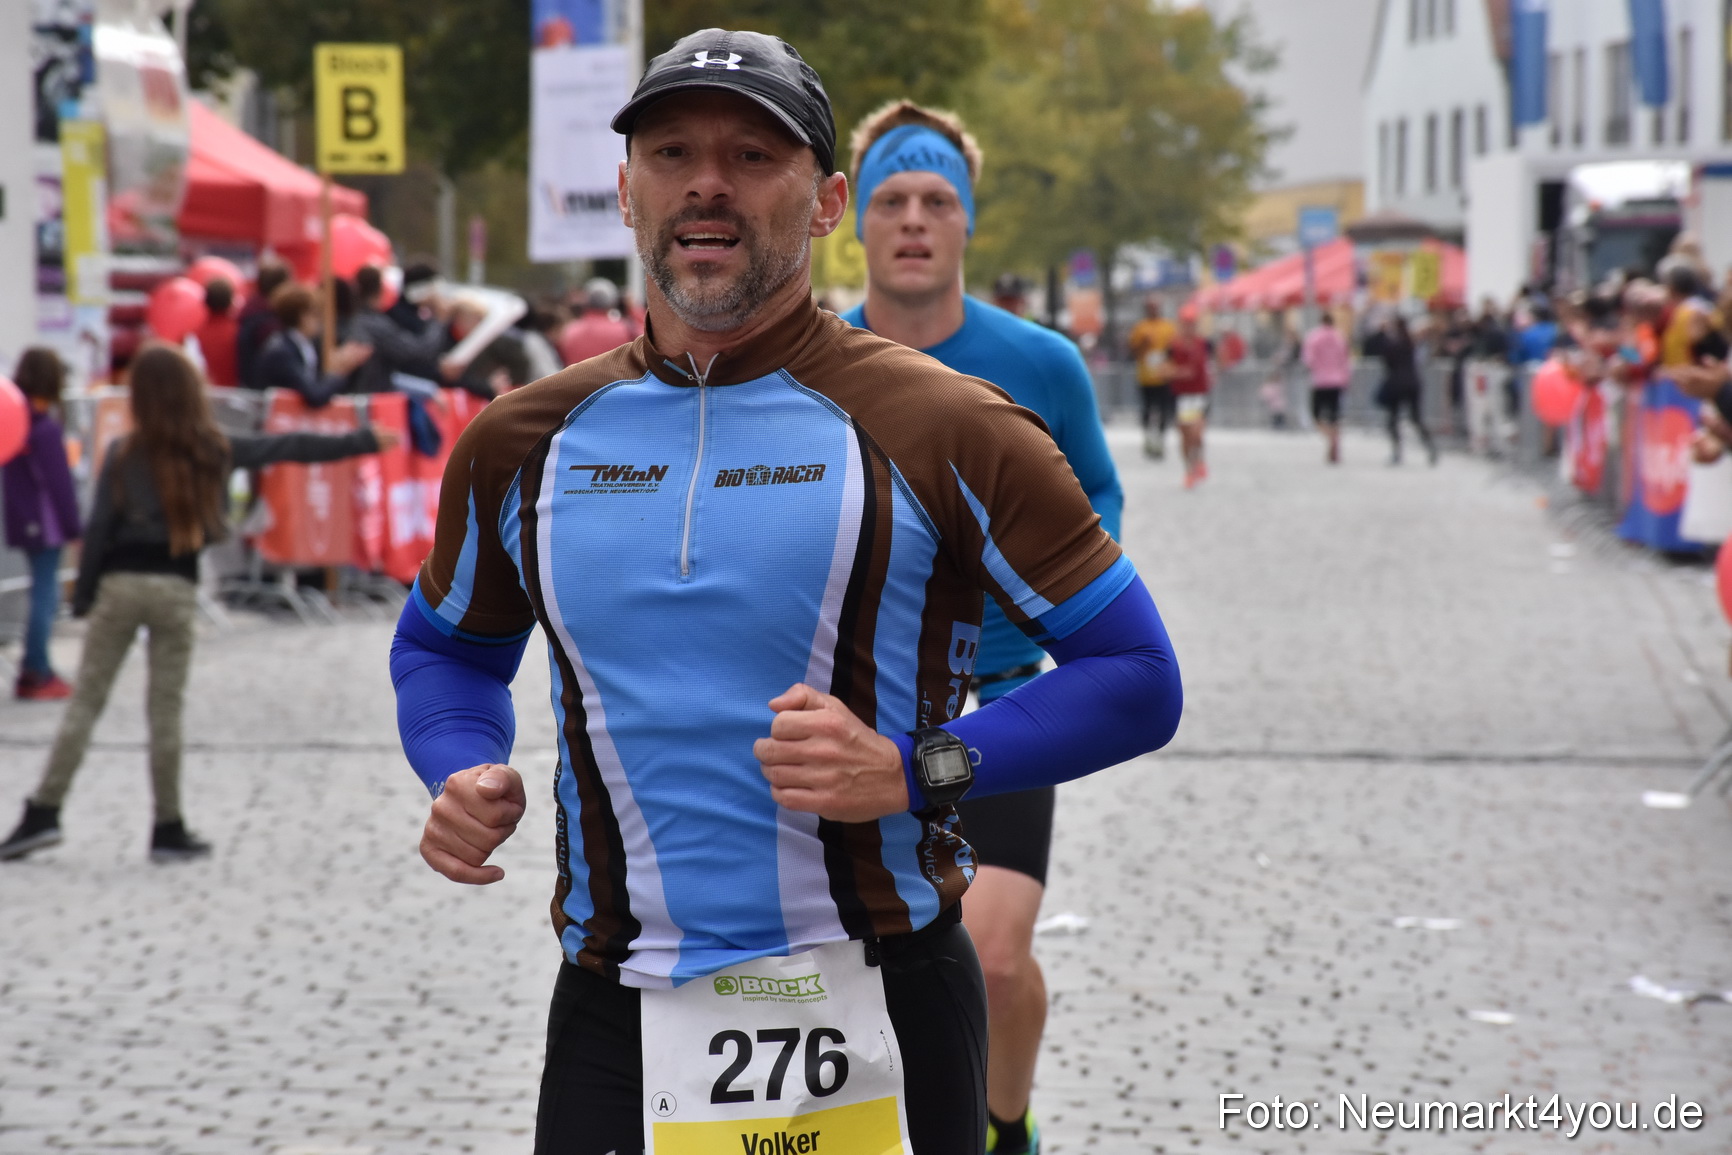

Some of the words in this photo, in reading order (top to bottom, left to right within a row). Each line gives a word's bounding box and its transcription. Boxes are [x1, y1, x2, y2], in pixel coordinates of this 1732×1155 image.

[341, 85, 380, 142] B
[771, 463, 827, 485] RACER
[739, 973, 826, 997] BOCK
[797, 994, 828, 1004] concepts
[708, 1027, 849, 1105] 276
[658, 1097, 669, 1111] A
[741, 1130, 821, 1155] Volker
